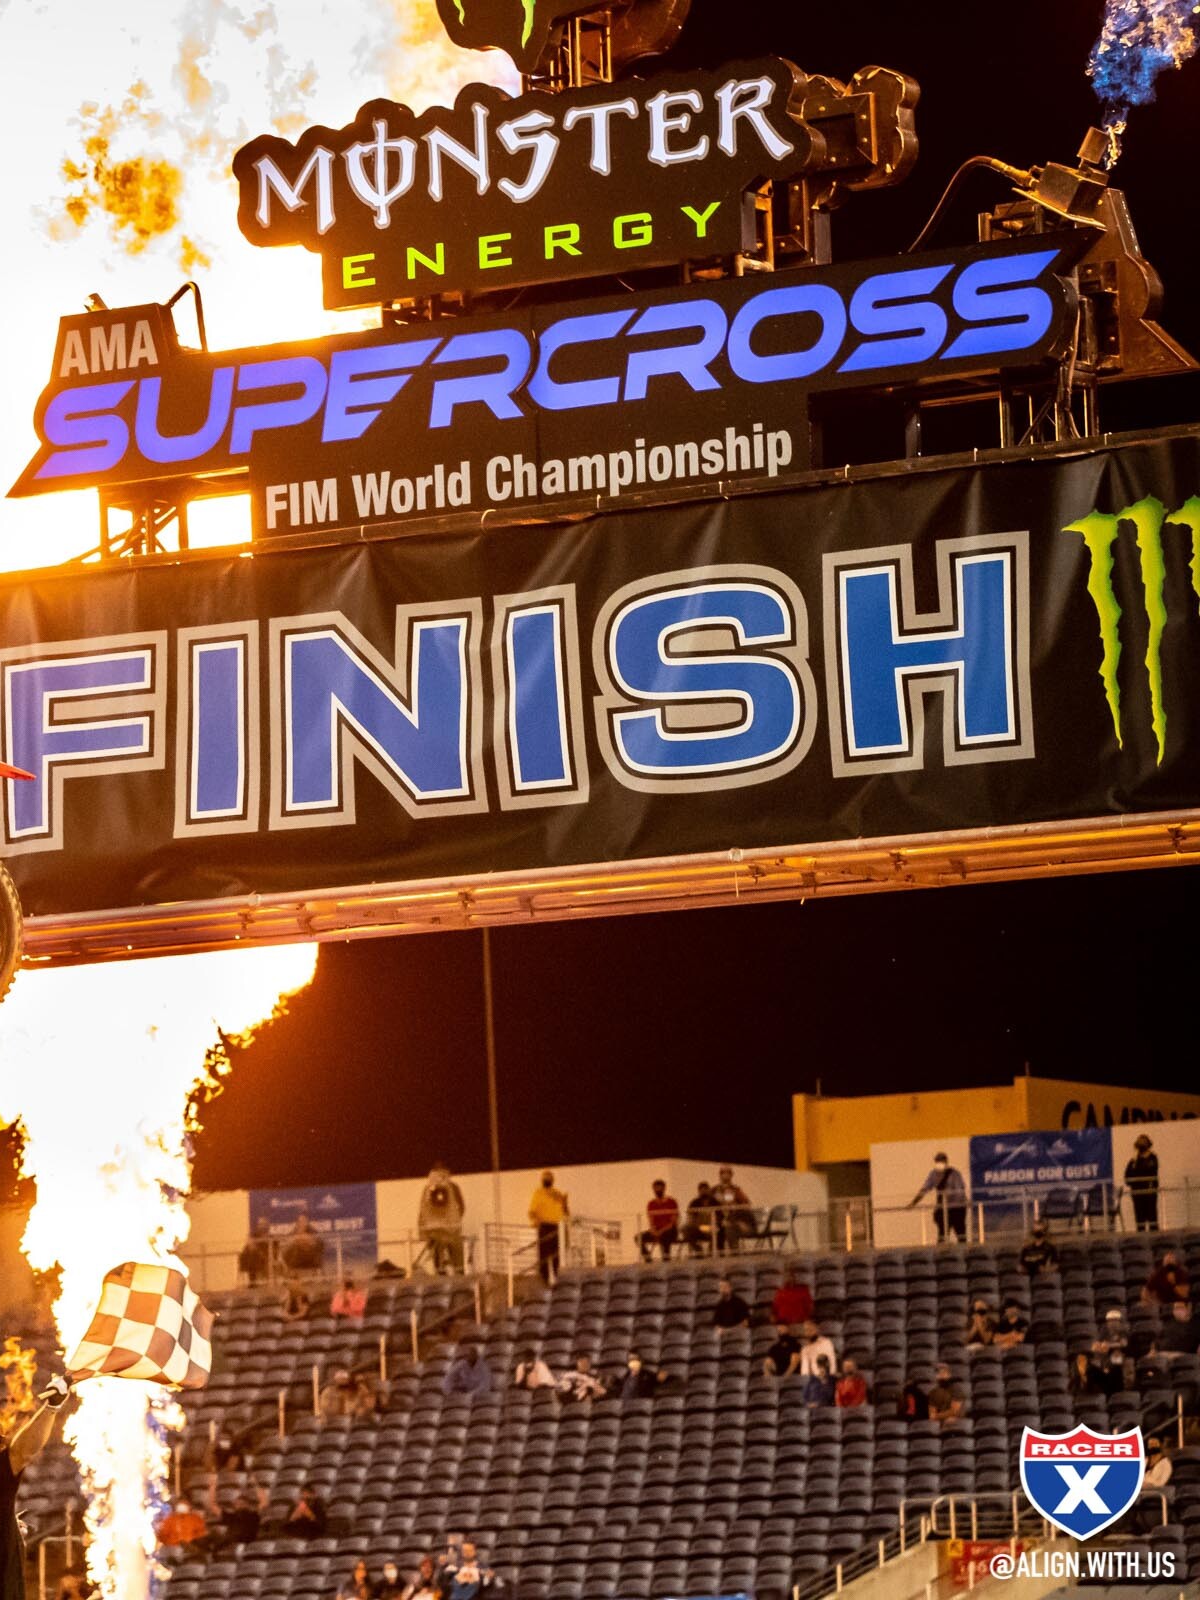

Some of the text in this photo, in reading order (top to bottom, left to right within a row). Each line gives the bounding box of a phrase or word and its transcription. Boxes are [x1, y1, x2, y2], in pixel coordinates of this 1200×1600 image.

[253, 73, 794, 235] MONSTER
[342, 201, 722, 289] ENERGY
[34, 249, 1064, 481] SUPERCROSS
[58, 319, 160, 379] AMA
[265, 424, 794, 531] FIM World Championship
